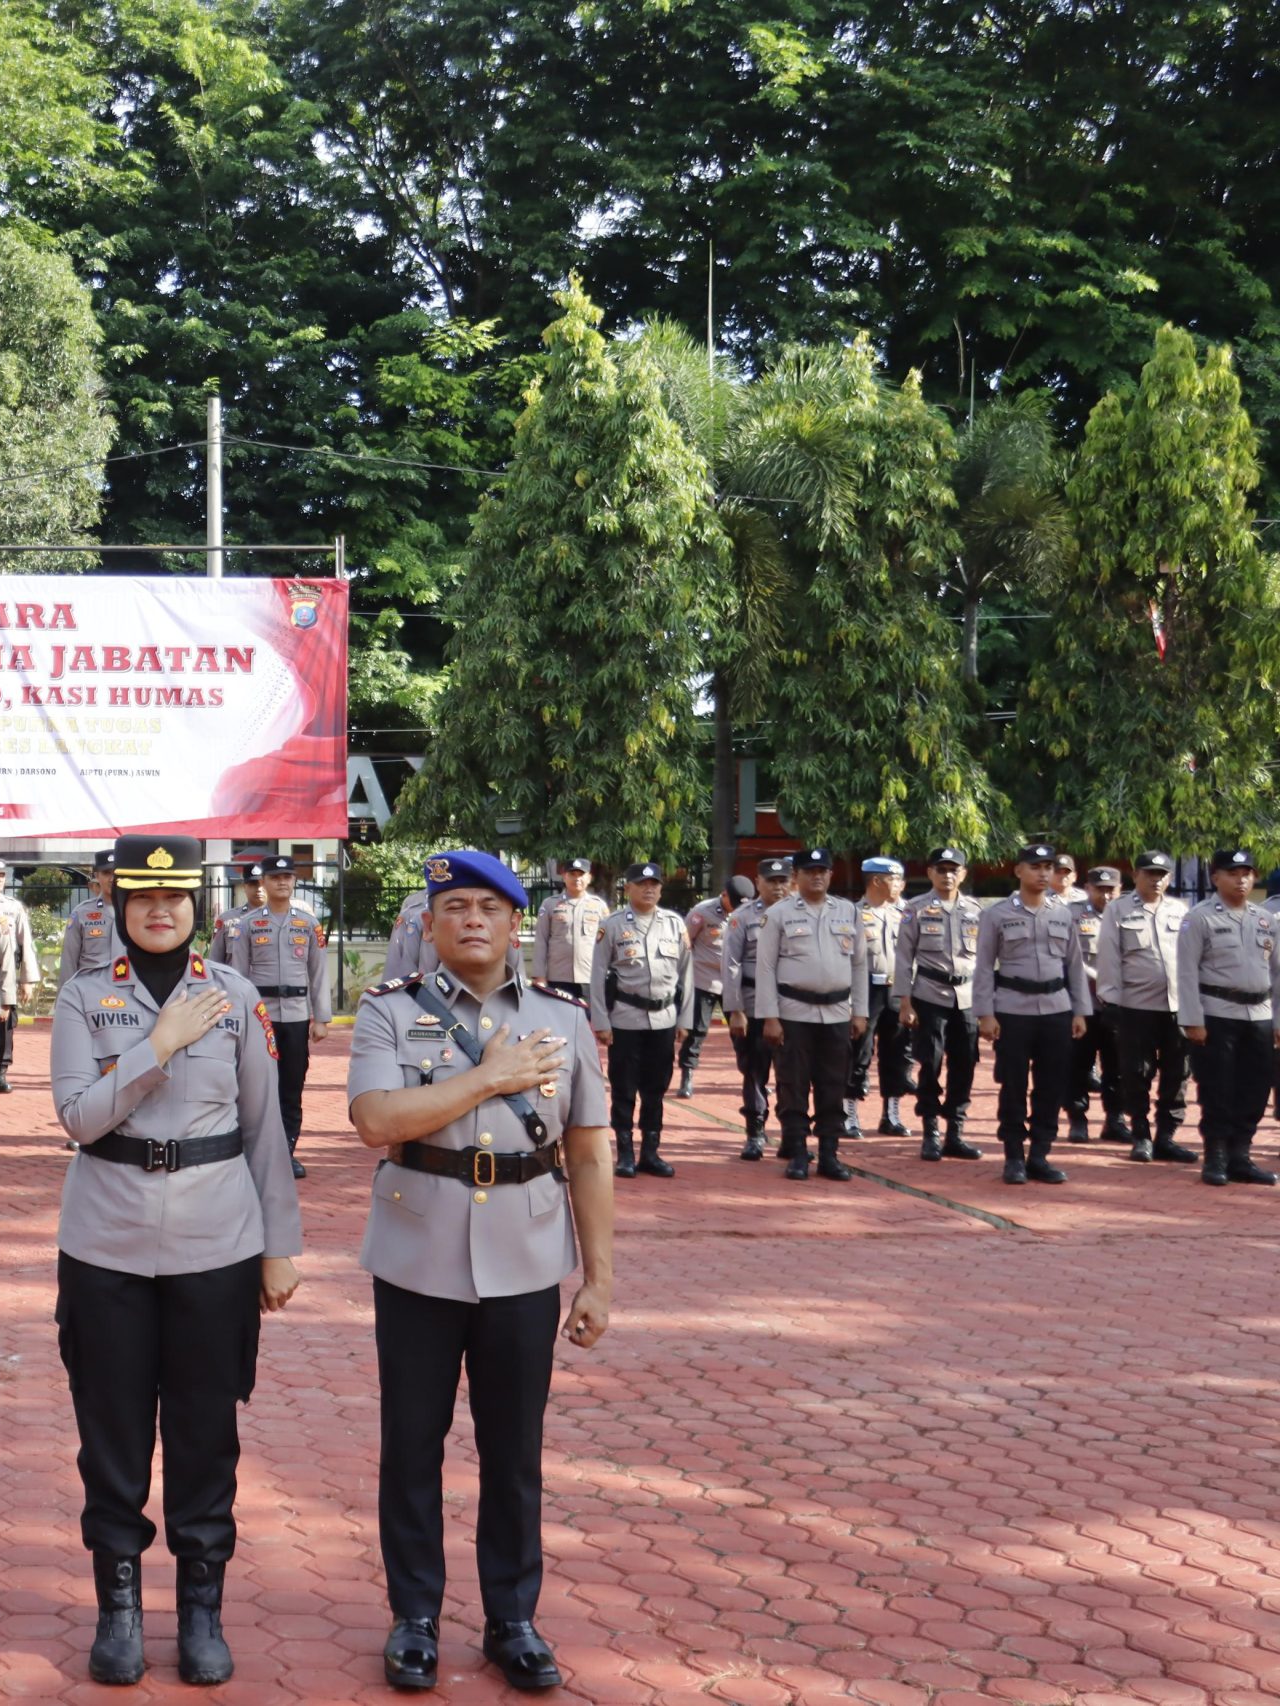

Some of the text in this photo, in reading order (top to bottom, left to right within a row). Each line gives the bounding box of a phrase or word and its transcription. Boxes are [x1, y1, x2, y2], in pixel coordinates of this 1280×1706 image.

[48, 643, 256, 680] JABATAN
[20, 685, 98, 706] KASI
[107, 686, 225, 708] HUMAS
[85, 716, 162, 734] TUGAS
[19, 768, 57, 776] DARSONO
[104, 769, 134, 777] (PURN.)
[135, 769, 161, 777] ASWIN
[289, 927, 310, 935] POLRI
[91, 1012, 139, 1028] VIVIEN
[215, 1018, 240, 1033] LRI
